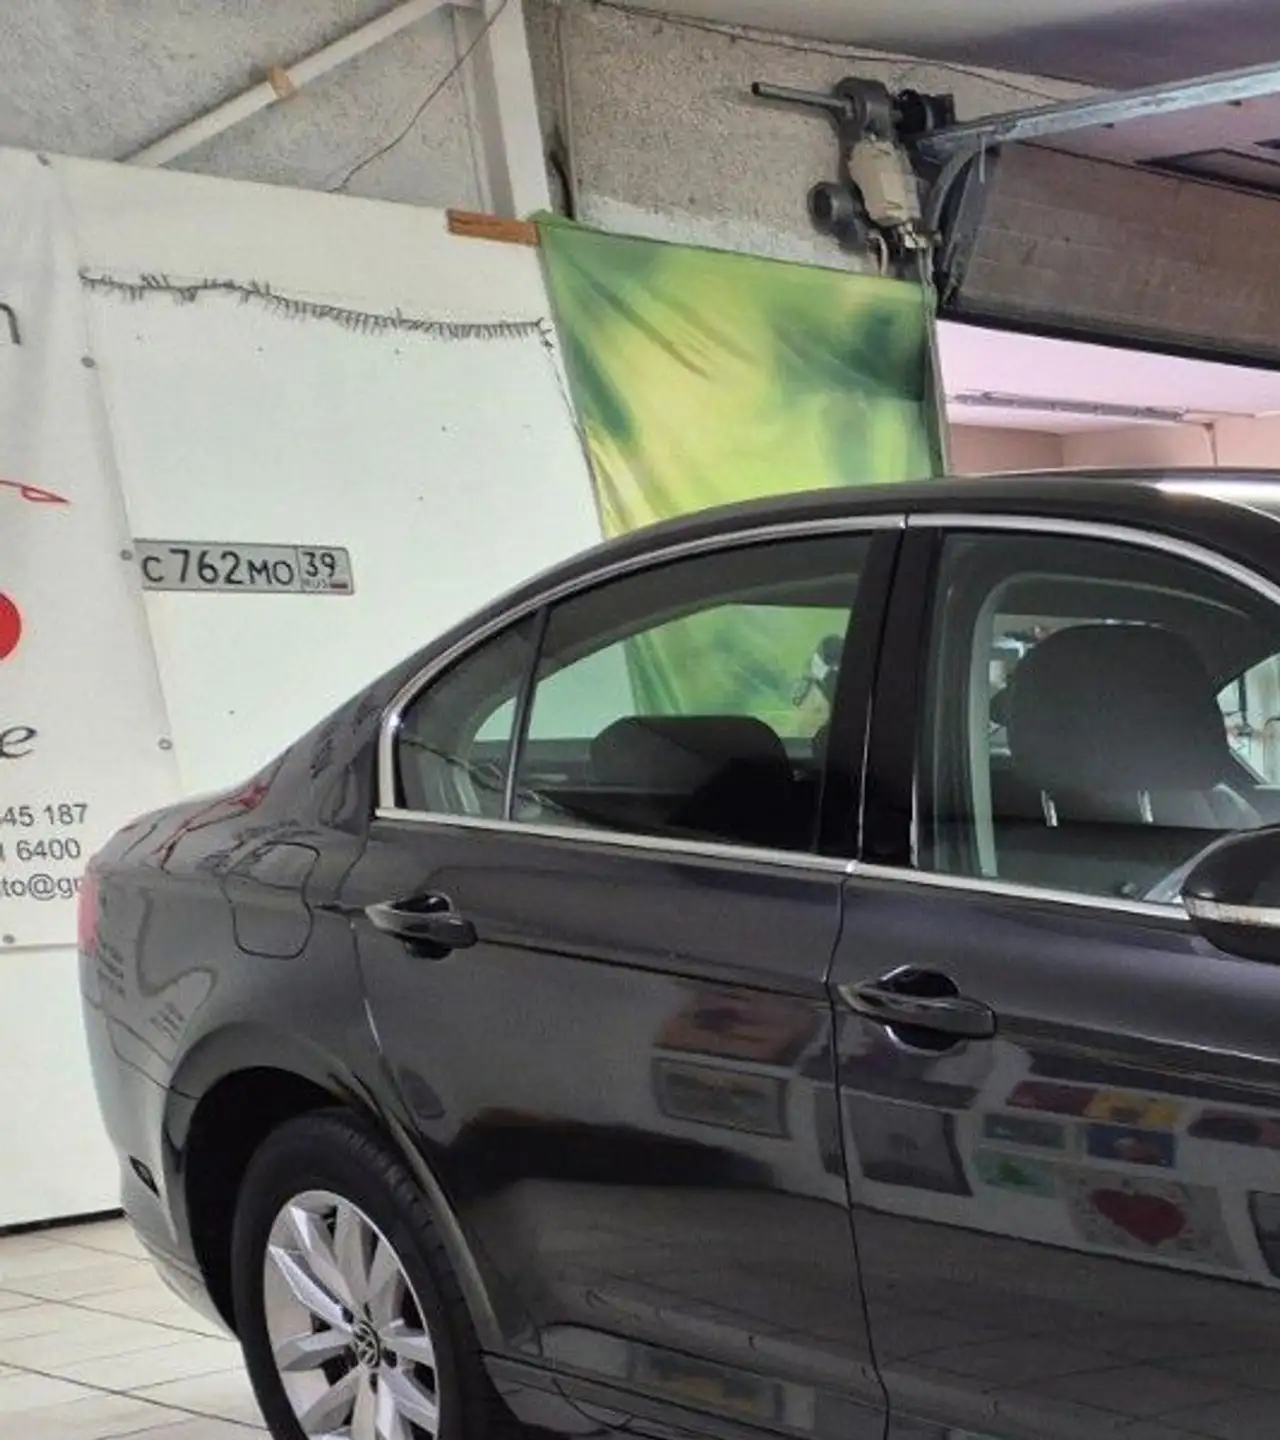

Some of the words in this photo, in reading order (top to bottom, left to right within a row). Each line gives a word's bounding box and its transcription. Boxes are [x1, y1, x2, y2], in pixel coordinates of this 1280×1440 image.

[301, 551, 335, 578] 39
[43, 803, 88, 826] 187
[16, 837, 81, 861] 6400
